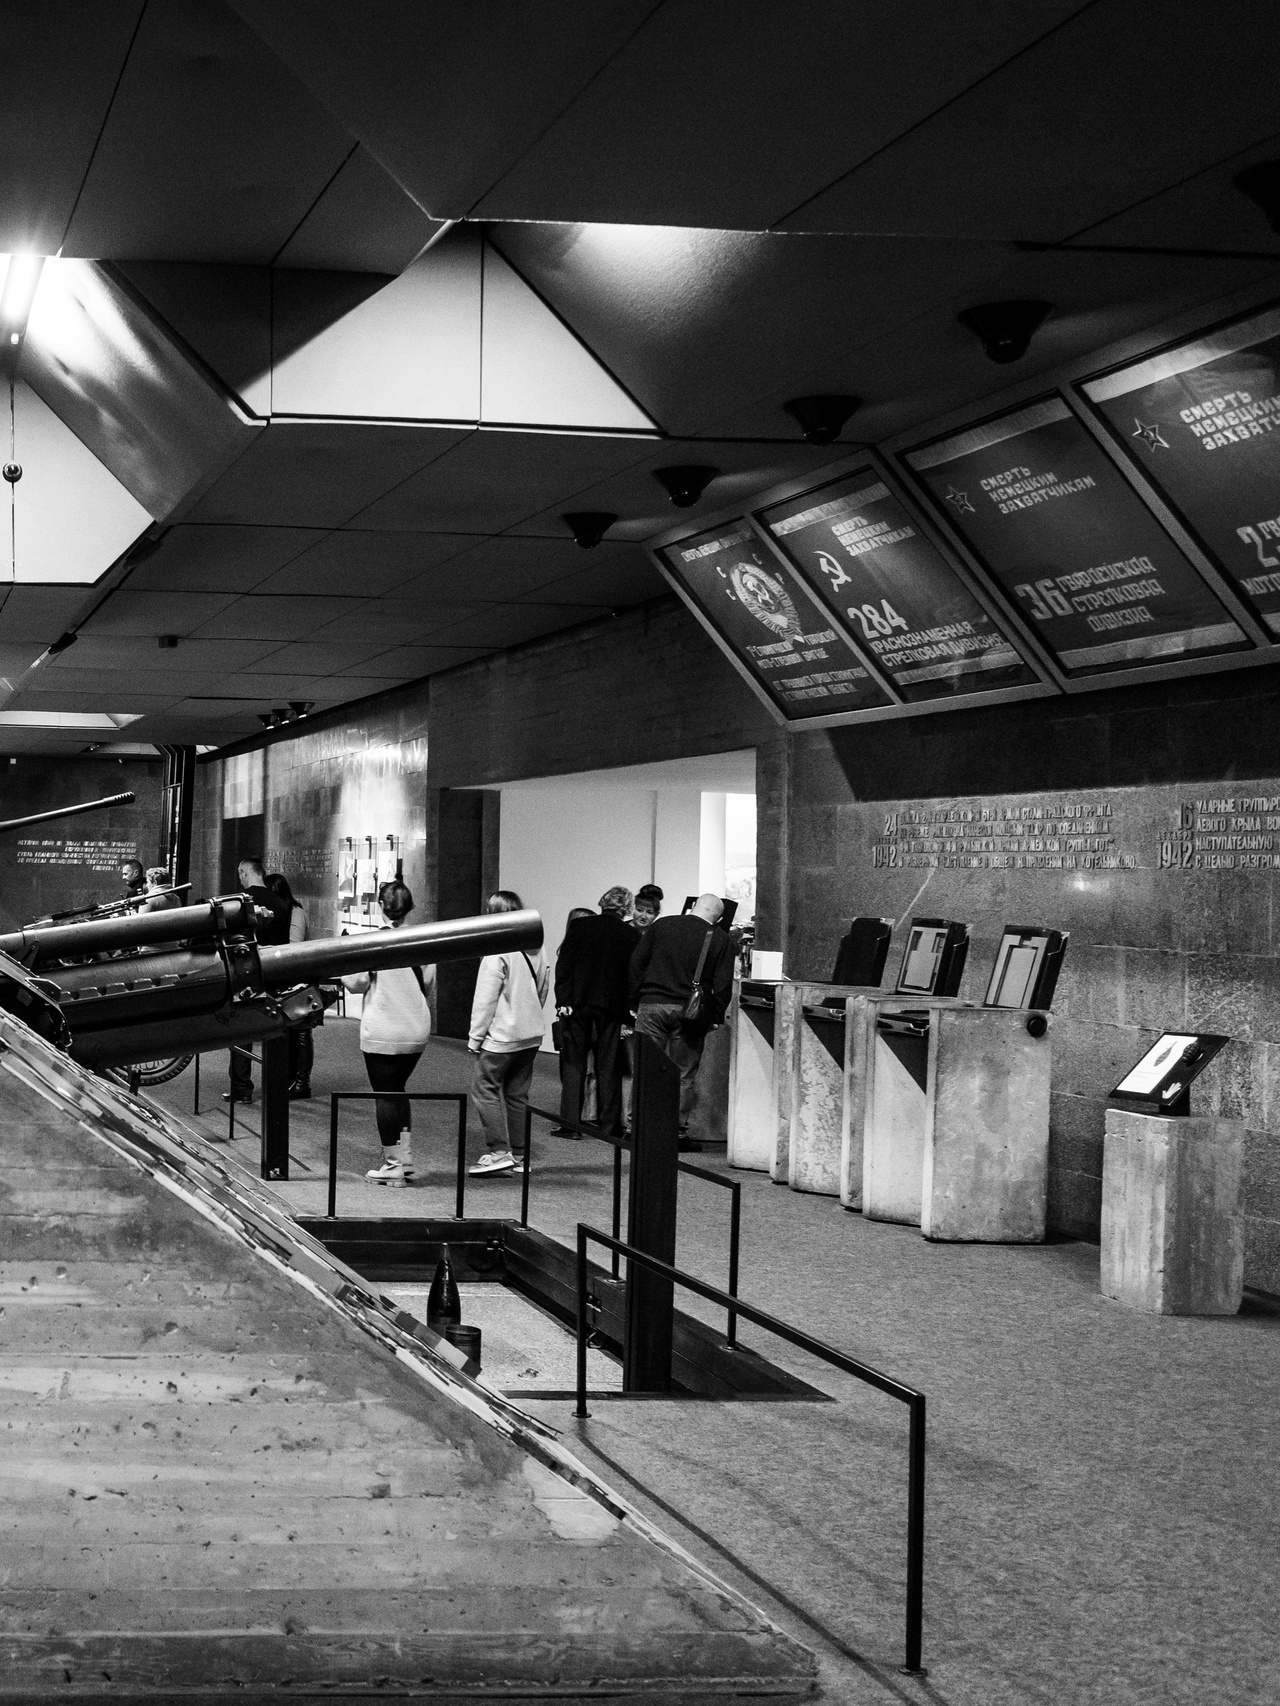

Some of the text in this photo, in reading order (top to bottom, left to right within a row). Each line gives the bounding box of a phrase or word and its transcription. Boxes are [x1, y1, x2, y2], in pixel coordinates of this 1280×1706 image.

[1179, 391, 1252, 423] СМЕРТЬ
[980, 466, 1031, 490] СМЕРТЬ
[988, 472, 1058, 502] НЕМЕЦКИМ
[998, 475, 1096, 514] ЗАХВАТЧИКАМ
[831, 516, 868, 536] СМЕРТЬ
[837, 521, 891, 547] НЕМЕЦКИМ
[846, 526, 916, 556] ЗАХВАТЧИКАМ
[1236, 526, 1280, 567] 2
[1013, 556, 1157, 620] 36 ГВАРДЕЙСКАЯ
[1072, 579, 1166, 612] СТРЕЛКОВАЯ
[847, 599, 909, 639] 284
[1086, 606, 1155, 632] ДИВИЗИЯ
[869, 621, 976, 654] КРАСНОЗНАМЕННАЯ
[882, 633, 1006, 666] СТРЕЛКОВАЯ ДИВИЗИЯ
[1196, 799, 1236, 814] УДАРНЫЕ
[884, 814, 900, 836] 24
[1196, 818, 1227, 832] ЛЕВОГО
[1232, 817, 1262, 832] КРЫЛА
[872, 845, 898, 868] 1942
[1158, 841, 1194, 870] 1942
[1196, 834, 1274, 851] НАСТУПАТЕЛЬНУЮ
[1204, 855, 1235, 871] ЦЕЛЬЮ
